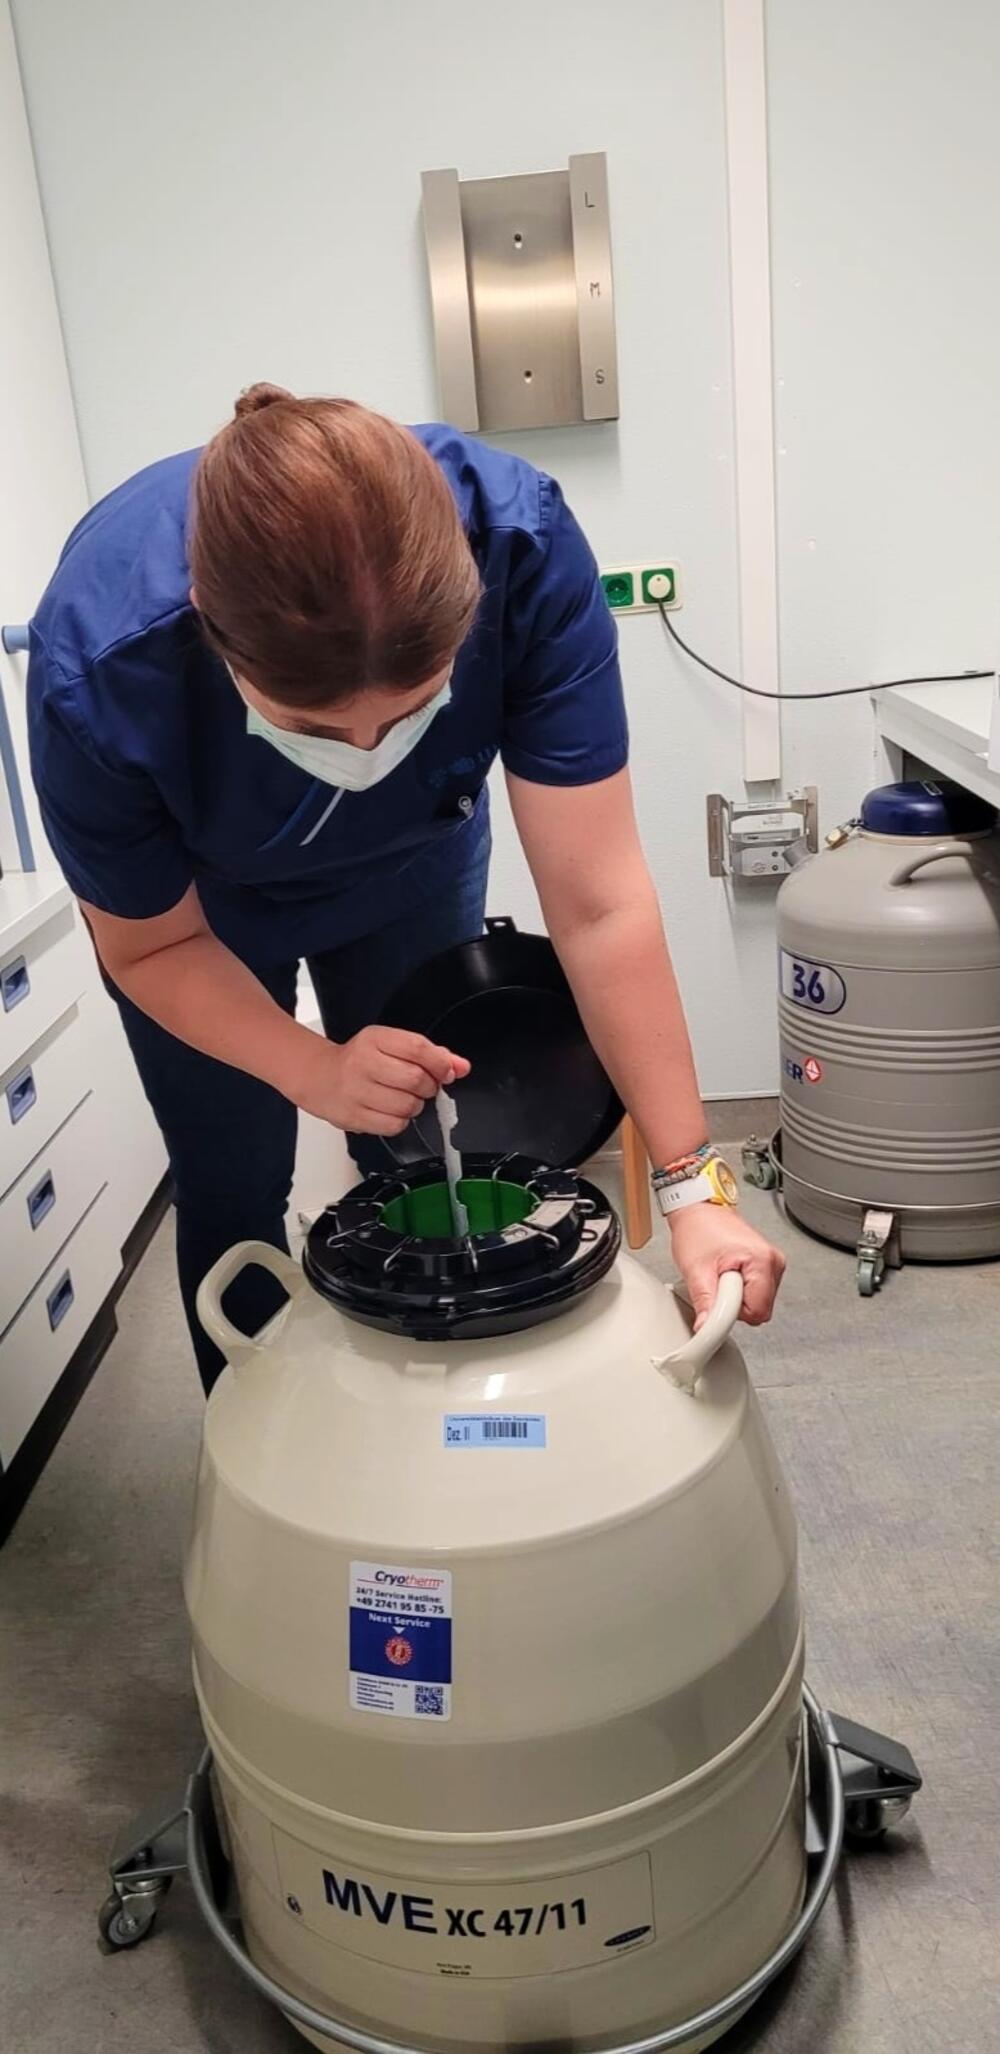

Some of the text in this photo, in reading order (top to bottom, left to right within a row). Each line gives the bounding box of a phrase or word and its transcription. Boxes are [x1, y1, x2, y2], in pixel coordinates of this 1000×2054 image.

[584, 191, 595, 208] L
[589, 281, 601, 298] M
[594, 368, 605, 385] S
[793, 963, 825, 1004] 36
[375, 1570, 441, 1587] Cryotherm
[356, 1586, 374, 1596] 24/7
[375, 1589, 405, 1600] Service
[356, 1596, 373, 1606] +49
[375, 1598, 398, 1609] 2741
[400, 1602, 412, 1611] 95
[414, 1603, 426, 1613] 85
[368, 1612, 432, 1628] Next Service
[322, 1869, 587, 1937] MVE XC 47/11
